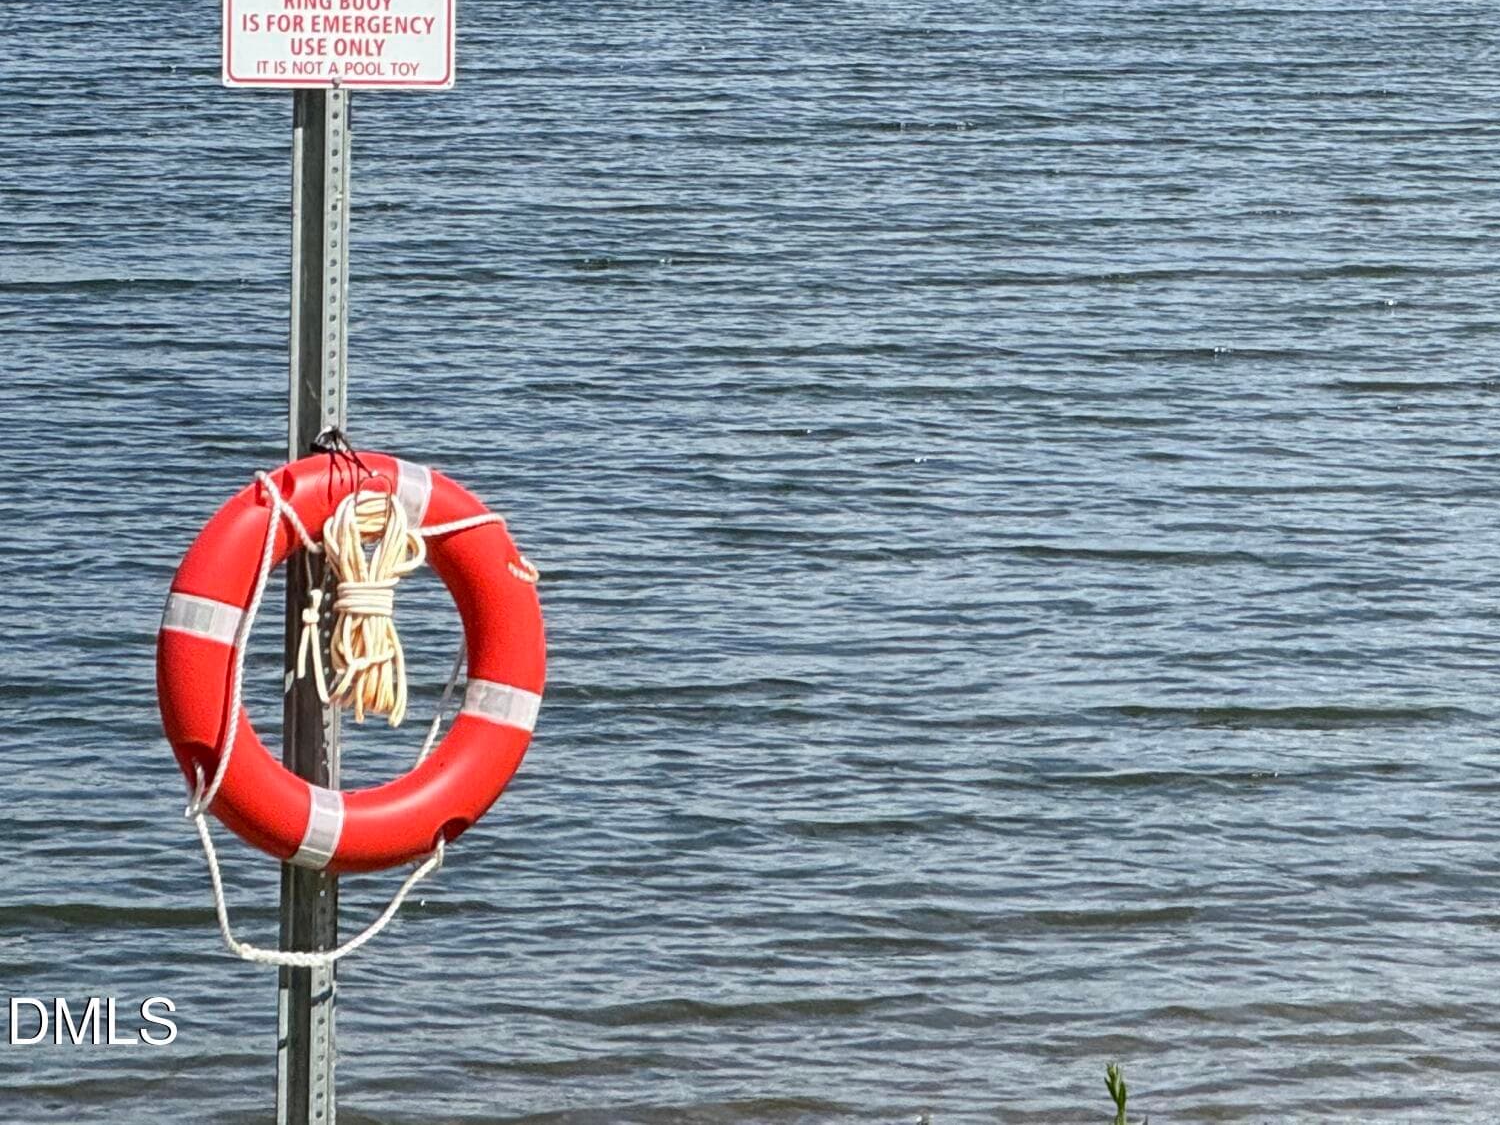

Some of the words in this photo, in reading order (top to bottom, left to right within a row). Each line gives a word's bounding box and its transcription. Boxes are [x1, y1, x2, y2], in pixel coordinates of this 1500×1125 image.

[242, 14, 260, 32] IS
[266, 14, 304, 33] FOR
[311, 15, 436, 35] EMERGENCY
[290, 38, 327, 56] USE
[333, 38, 386, 57] ONLY
[256, 60, 269, 74] IT
[274, 61, 286, 75] IS
[292, 61, 323, 75] NOT
[328, 61, 340, 75] A
[344, 62, 385, 76] POOL
[390, 62, 420, 76] TOY
